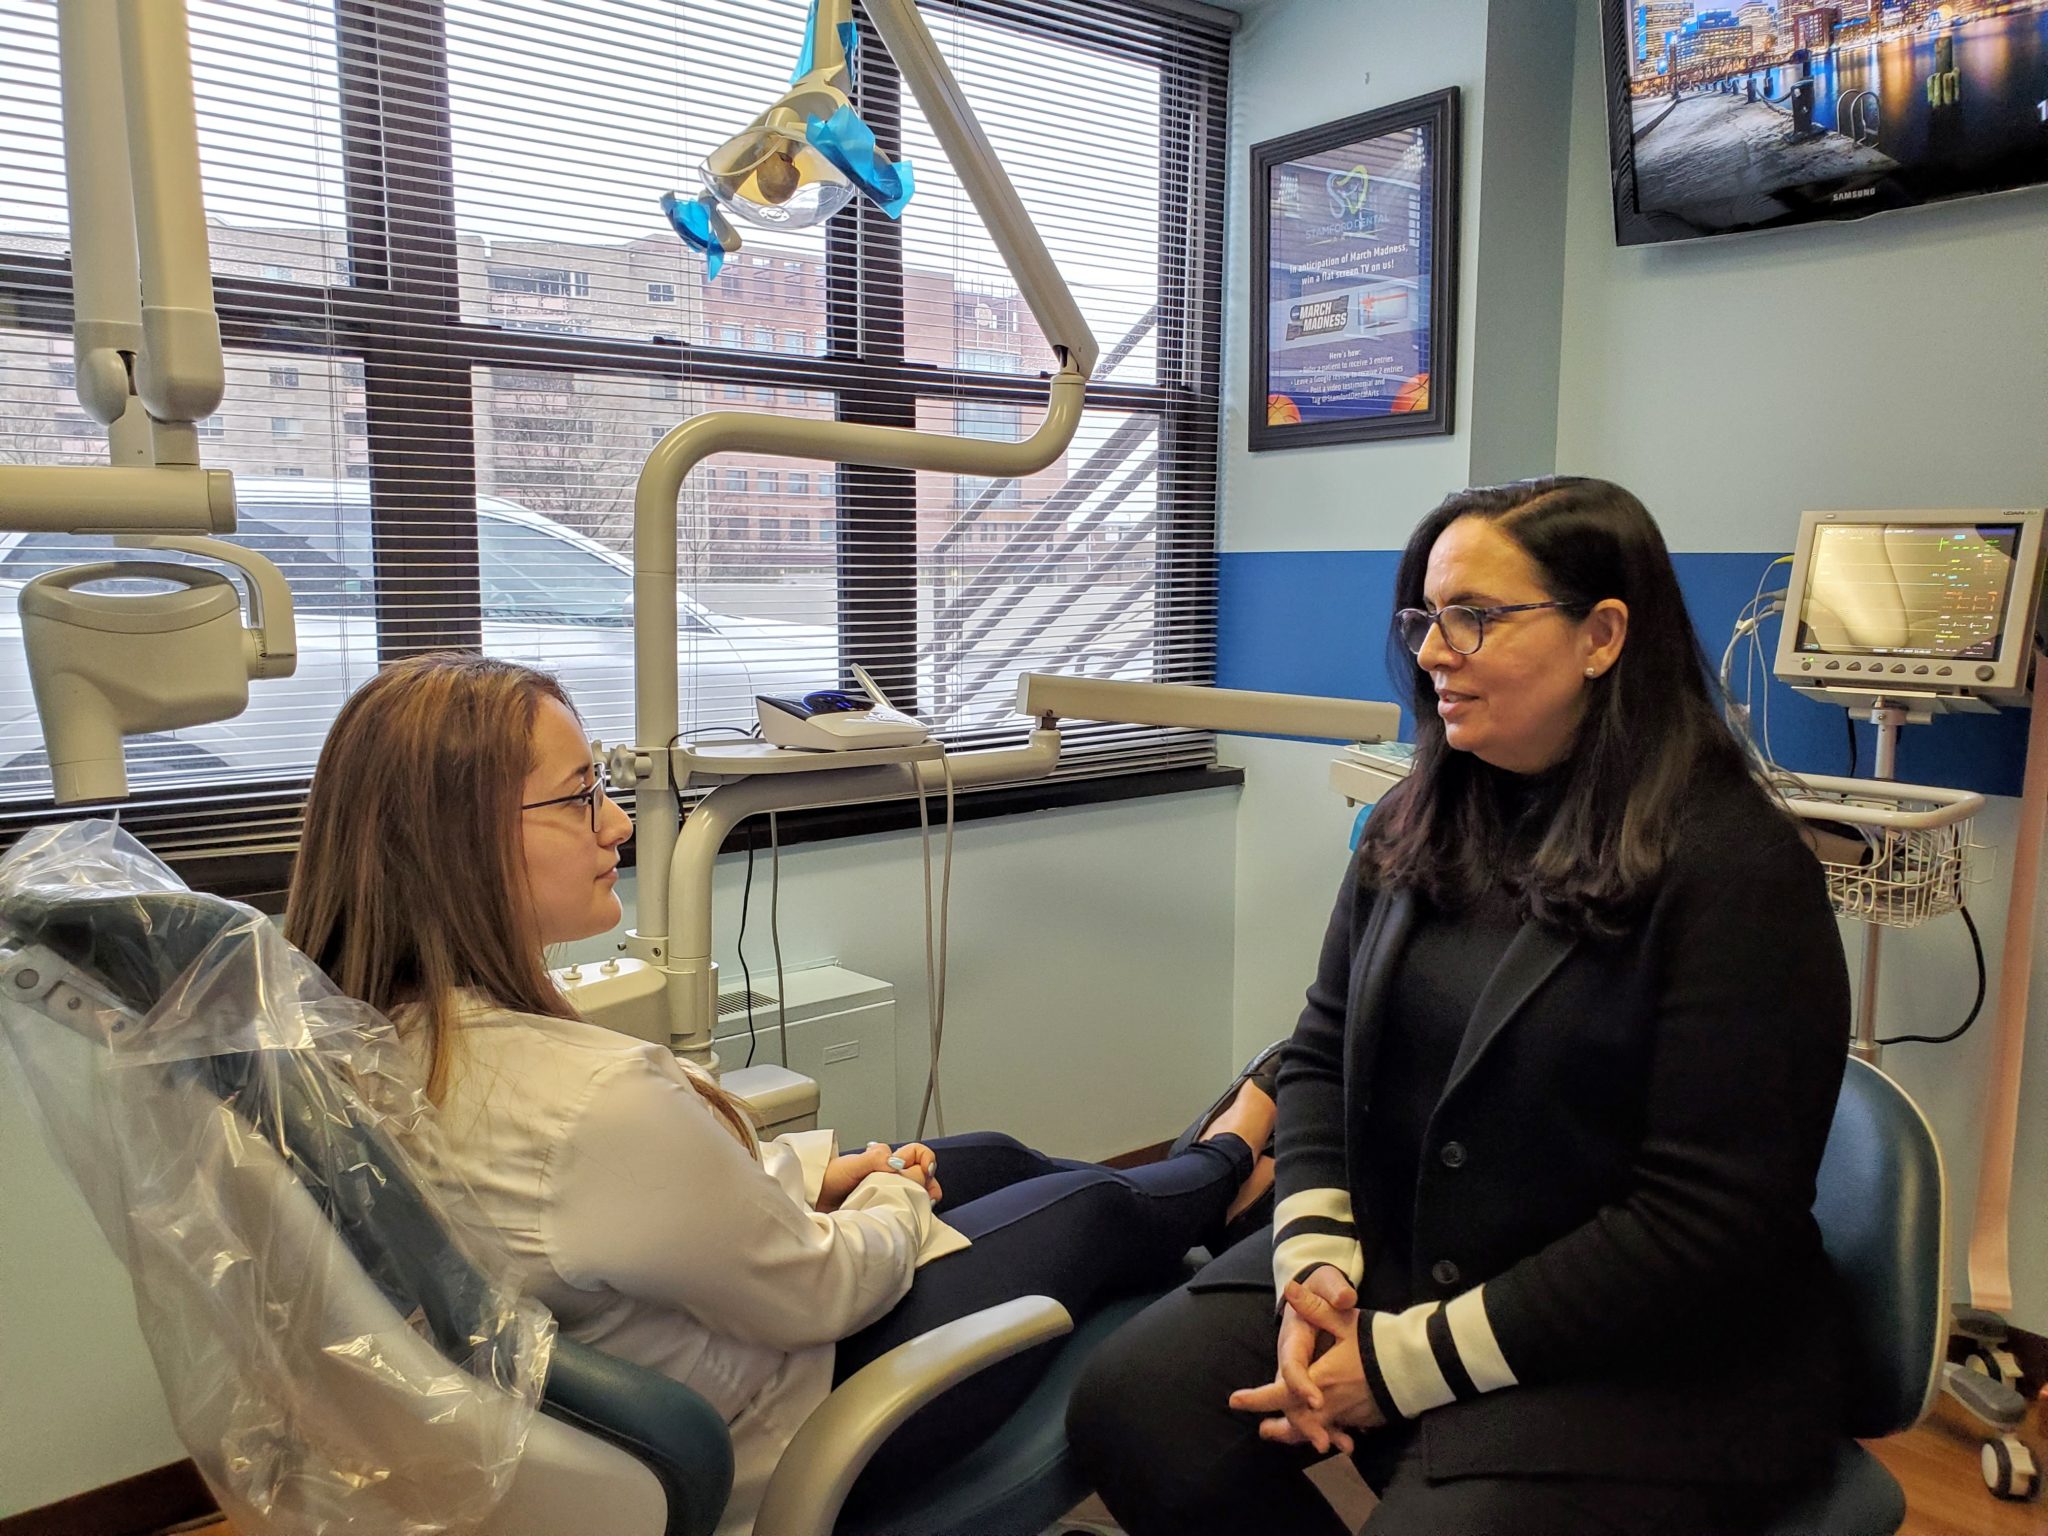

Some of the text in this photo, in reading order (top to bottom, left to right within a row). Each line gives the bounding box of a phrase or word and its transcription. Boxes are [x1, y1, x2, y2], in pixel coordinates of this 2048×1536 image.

[1833, 187, 1875, 201] SAMSUNG
[1305, 220, 1353, 240] STAMFORD
[1354, 213, 1390, 230] DENTAL
[1290, 243, 1409, 274] In anticipation of March Madness,
[1302, 275, 1314, 285] win
[1322, 269, 1334, 281] flat
[1336, 267, 1359, 279] screen
[1361, 263, 1370, 273] TV
[1371, 263, 1380, 272] on
[1383, 258, 1394, 270] us!
[1300, 302, 1332, 319] MARCH
[1303, 313, 1347, 332] MADNESS
[1329, 350, 1346, 360] Here's
[1342, 360, 1348, 369] to
[1349, 357, 1368, 368] receive
[1369, 357, 1373, 365] 3
[1374, 355, 1394, 365] entries
[1294, 377, 1309, 386] Leave
[1314, 373, 1331, 385] Google
[1379, 366, 1383, 375] 2
[1384, 364, 1404, 374] entries
[1327, 382, 1342, 392] video
[1375, 377, 1386, 387] and
